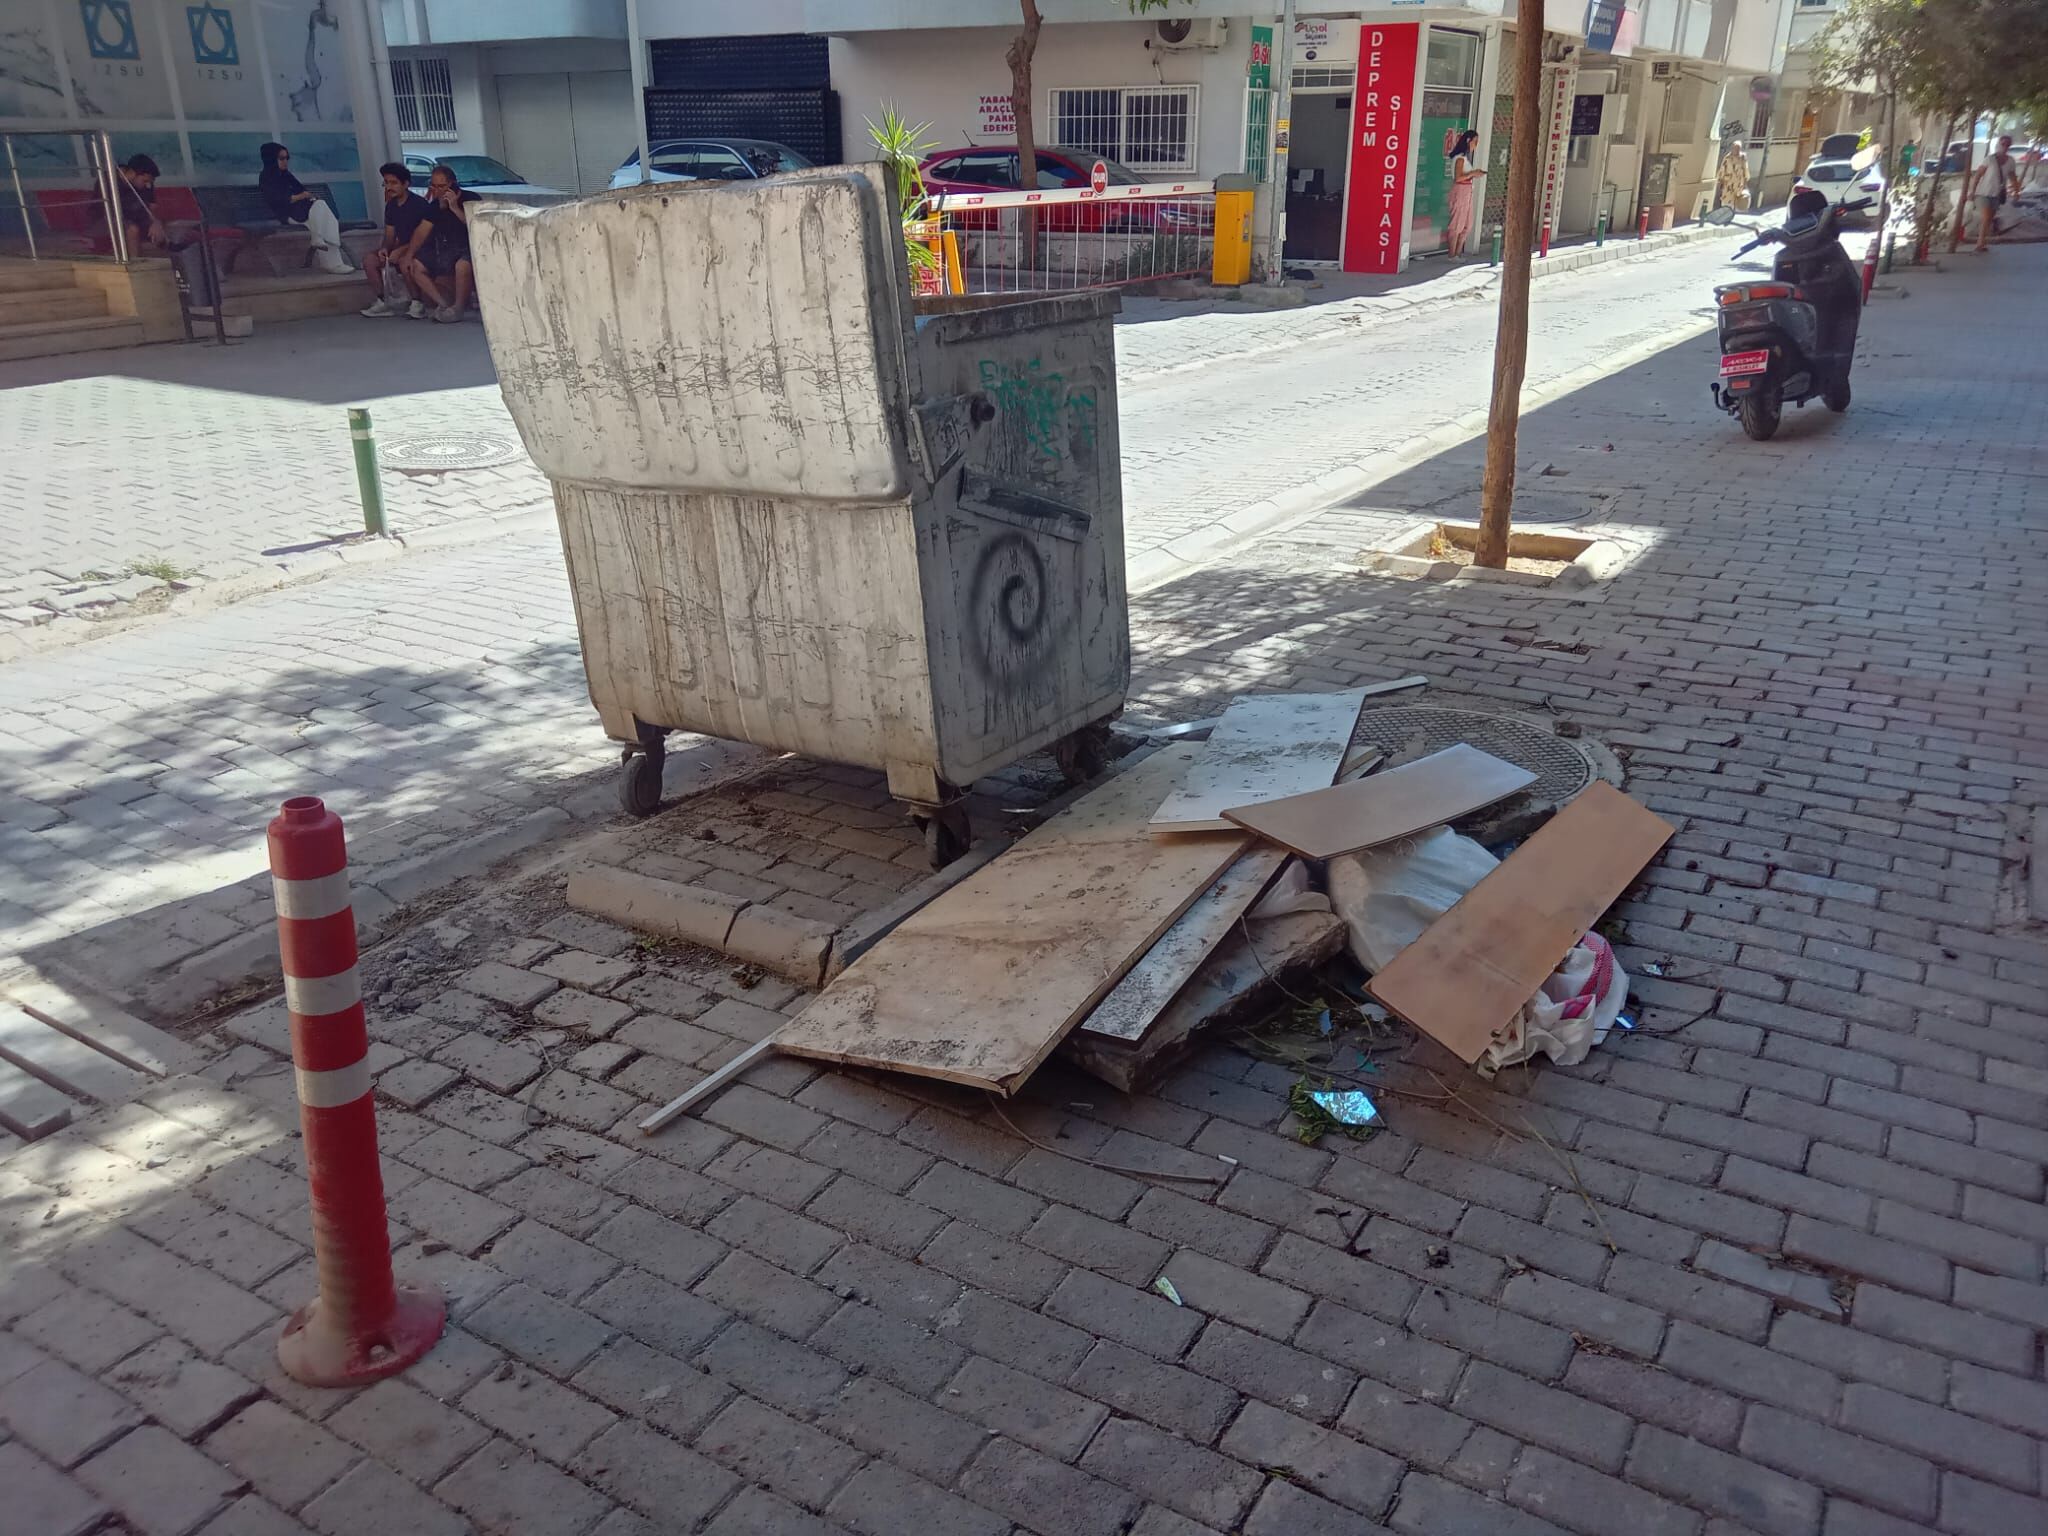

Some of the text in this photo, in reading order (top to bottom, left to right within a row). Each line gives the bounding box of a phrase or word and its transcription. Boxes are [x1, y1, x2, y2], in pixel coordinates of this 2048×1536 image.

[1362, 31, 1383, 147] DEPREM
[979, 105, 1011, 114] ARAÇL
[983, 124, 1015, 132] EDEME
[1094, 172, 1105, 183] DUR
[1378, 95, 1401, 265] SİGORTASI
